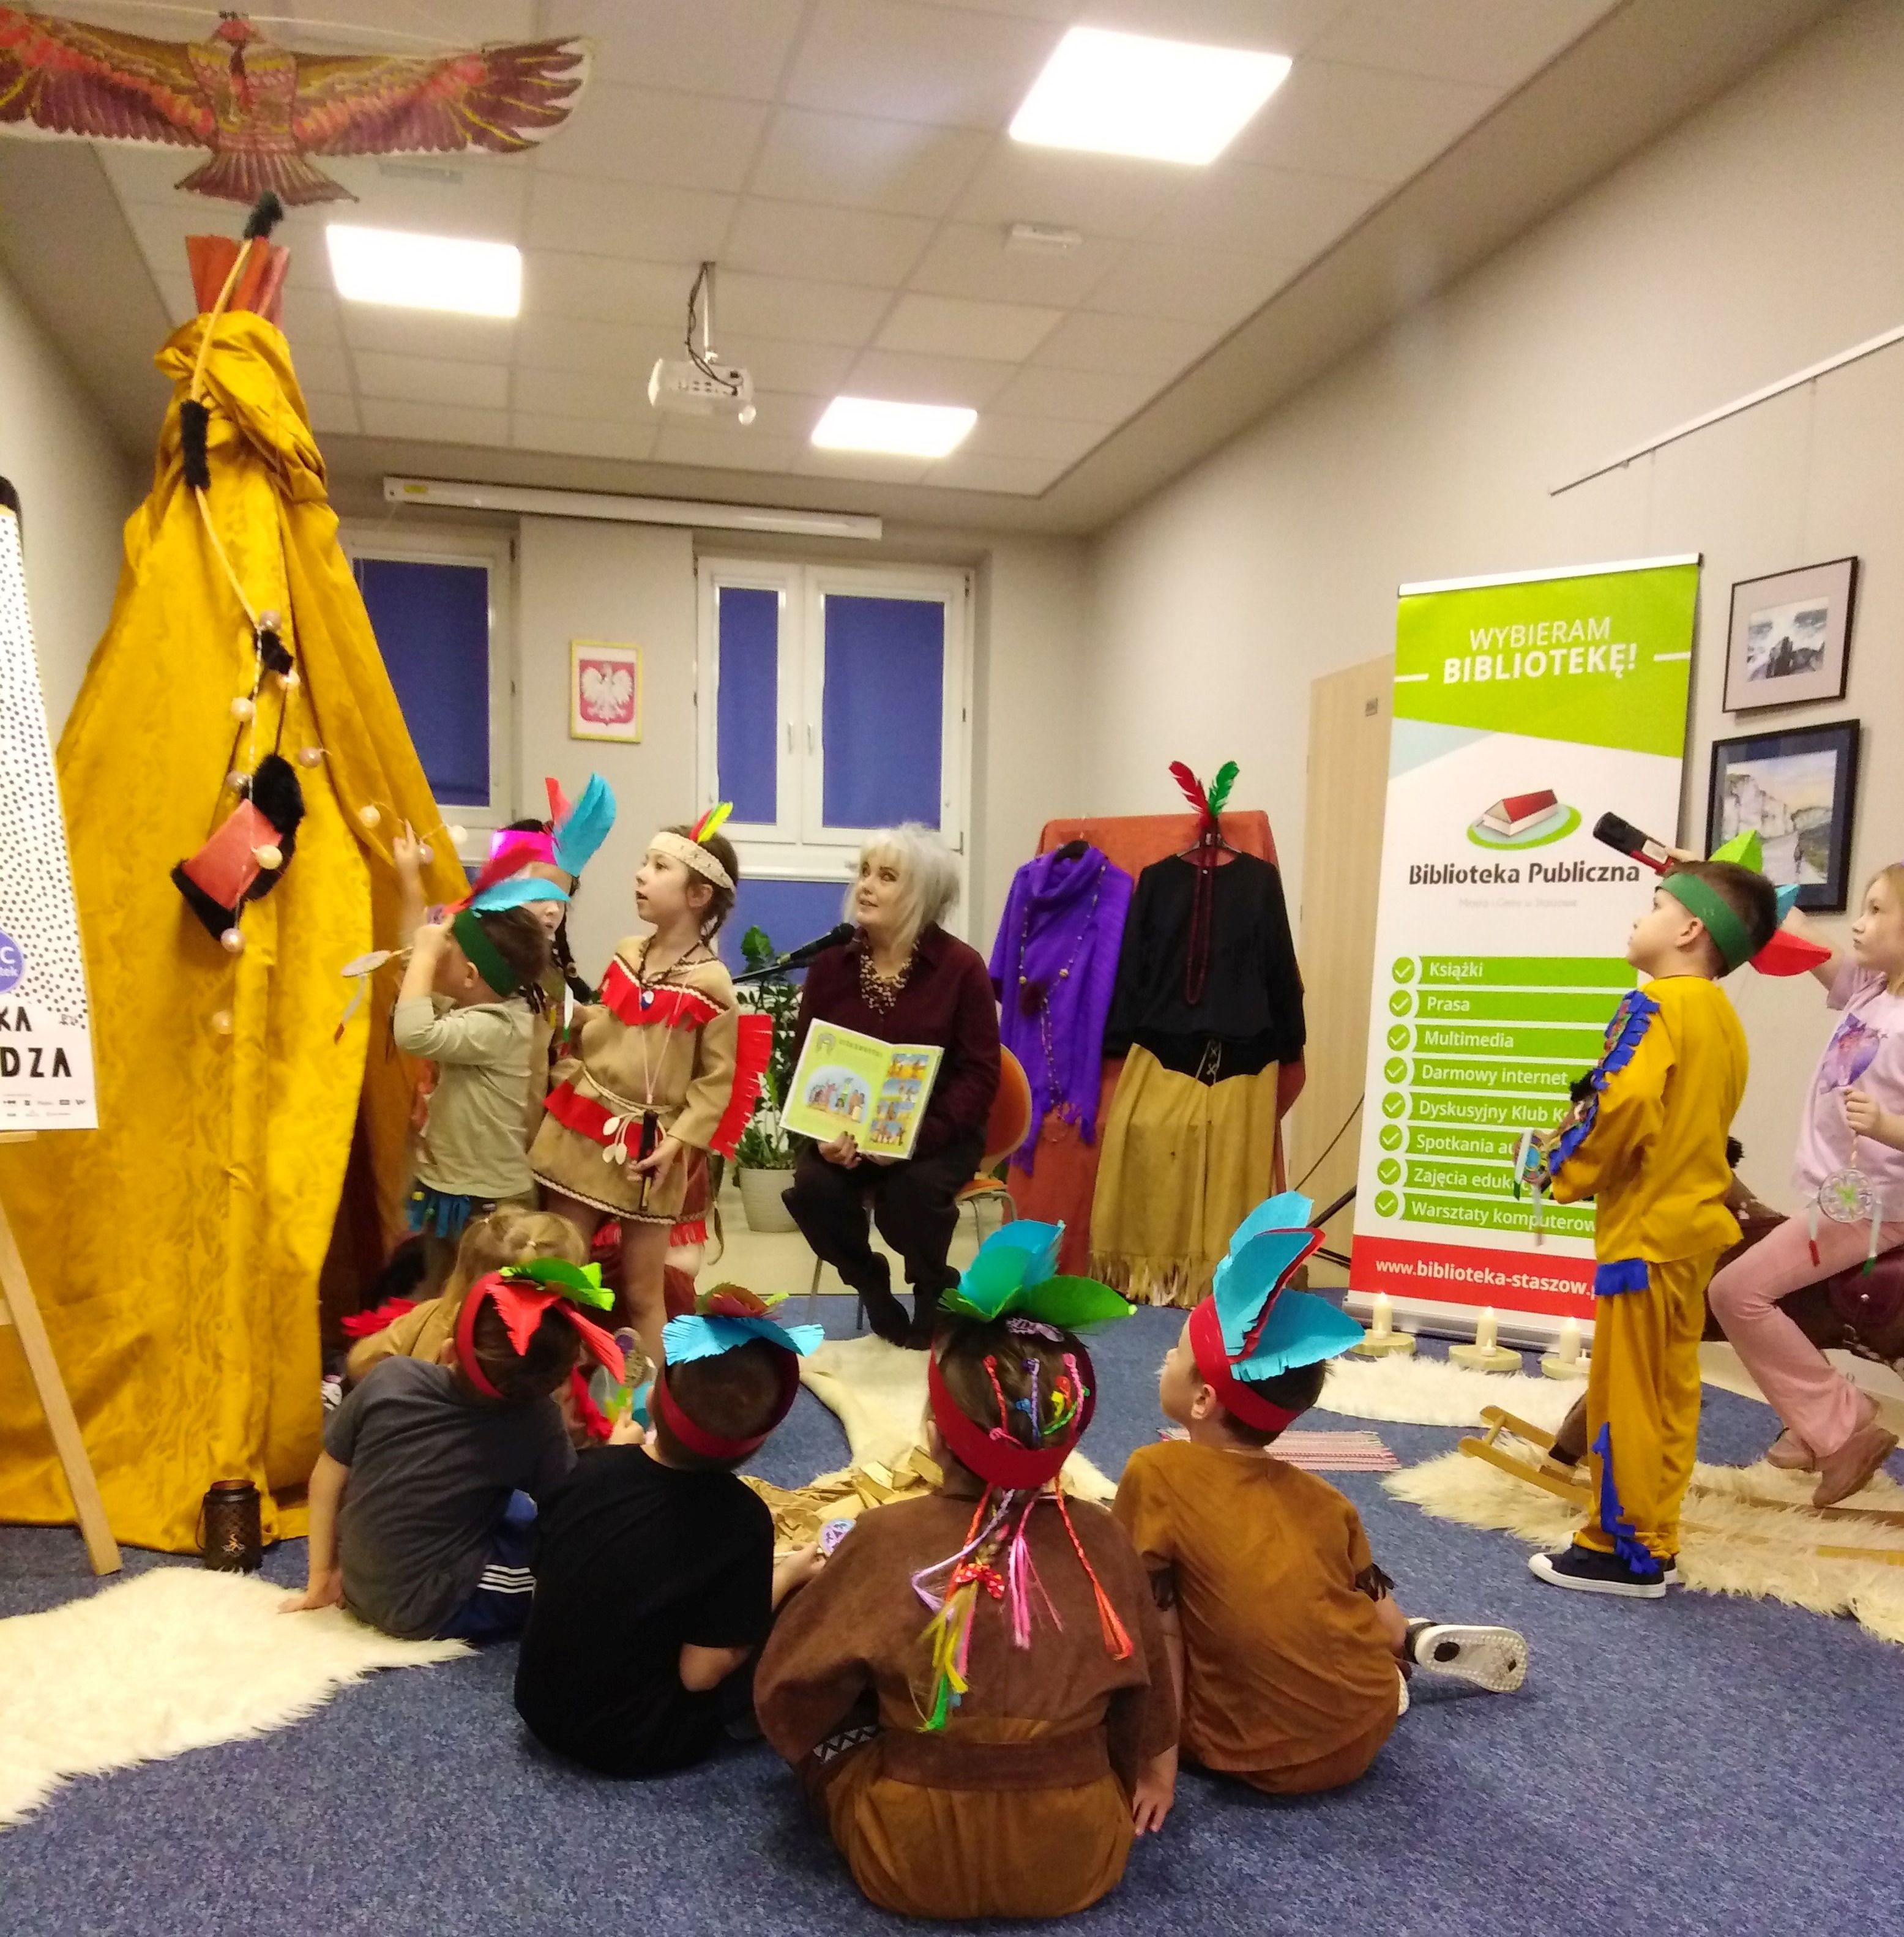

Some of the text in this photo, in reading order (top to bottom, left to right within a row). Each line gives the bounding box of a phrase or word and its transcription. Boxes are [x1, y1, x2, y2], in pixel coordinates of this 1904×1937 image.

[1469, 616, 1610, 651] WYBIERAM
[1443, 642, 1637, 684] BIBLIOTEKĘ!
[1409, 860, 1640, 885] Biblioteka Publiczna
[1430, 961, 1484, 980] Książki
[1427, 996, 1470, 1012] Prasa
[1425, 1030, 1514, 1048] Multimedia
[1422, 1064, 1569, 1086] Darmowy internet
[1419, 1100, 1508, 1124] Dyskusyjny
[1512, 1105, 1548, 1122] Klub
[1416, 1133, 1495, 1153] Spotkania
[1414, 1168, 1468, 1187] Zajęcia
[1412, 1201, 1489, 1225] Warsztaty
